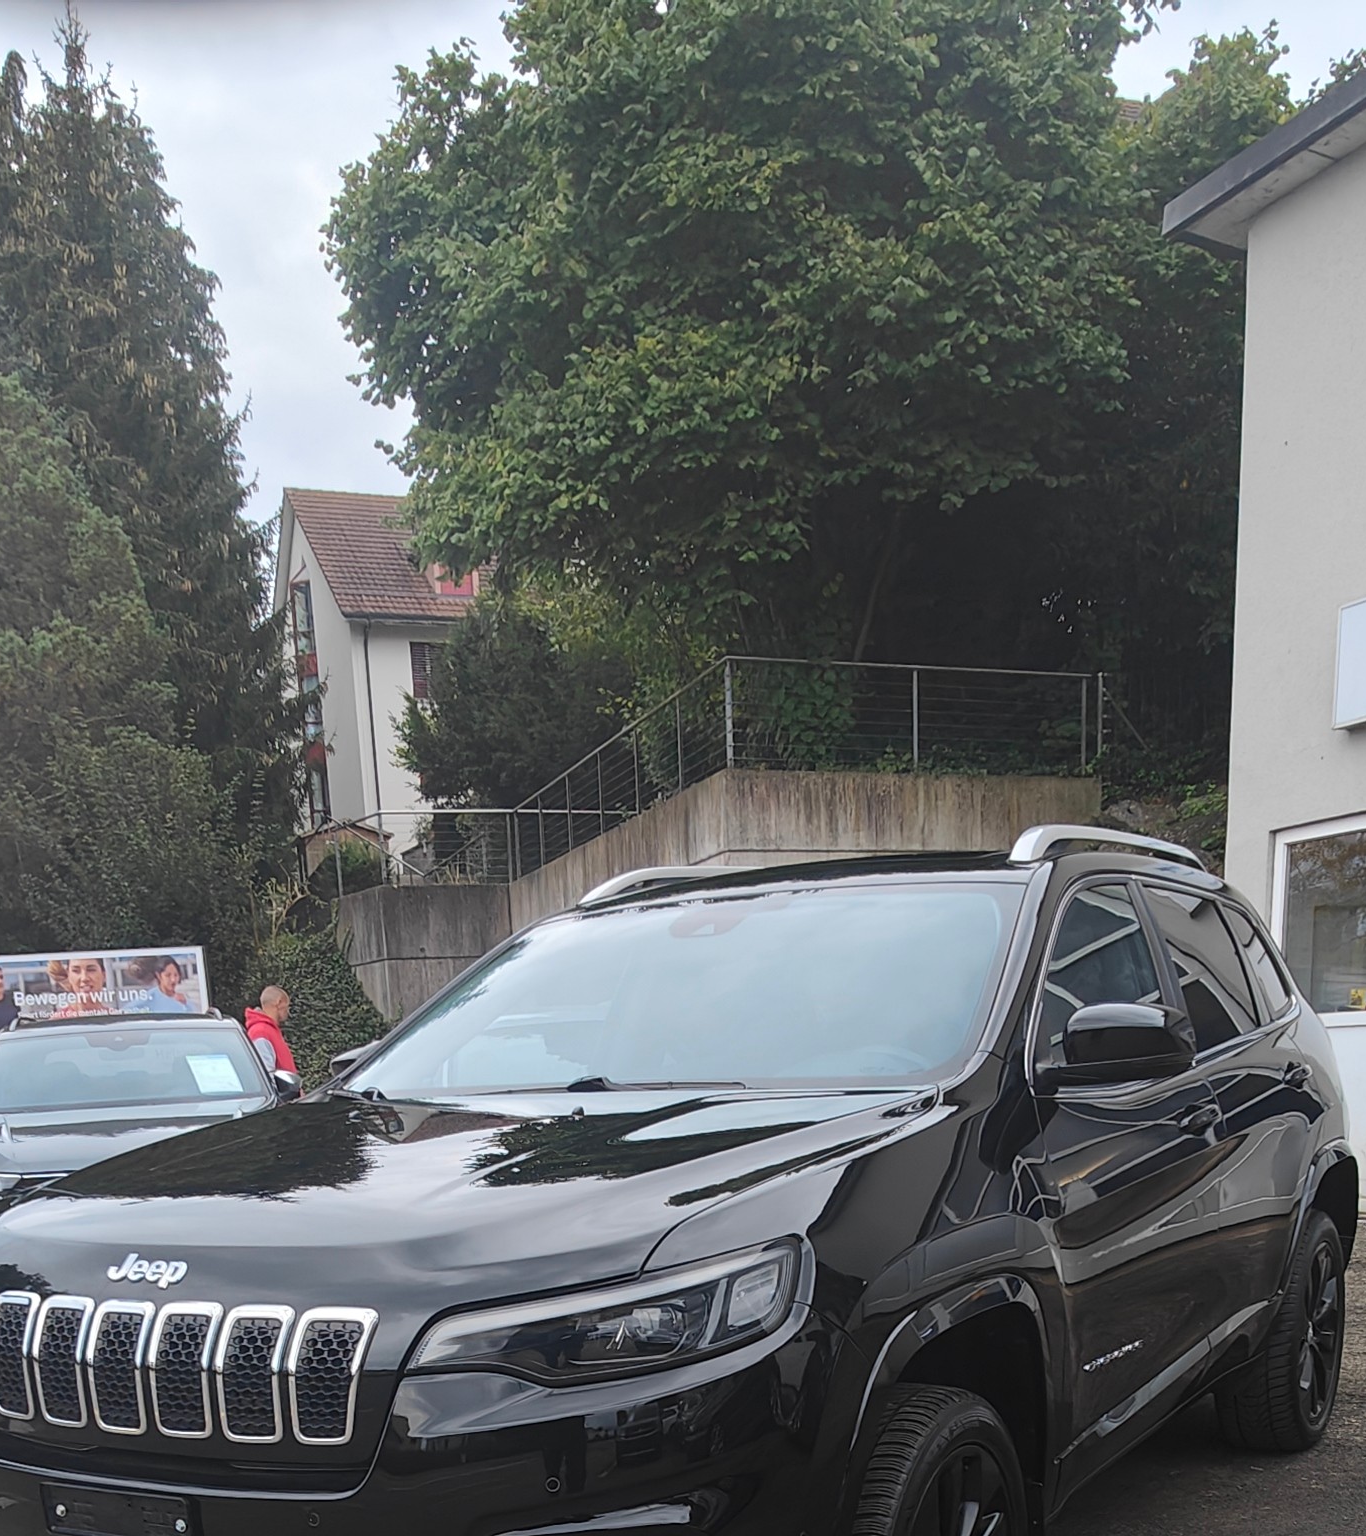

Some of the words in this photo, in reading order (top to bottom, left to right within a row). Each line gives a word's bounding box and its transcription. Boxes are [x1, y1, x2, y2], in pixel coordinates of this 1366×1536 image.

[13, 991, 87, 1007] Bewegen
[89, 988, 117, 1004] wir
[118, 988, 153, 1002] uns.
[107, 1252, 188, 1290] Jeep
